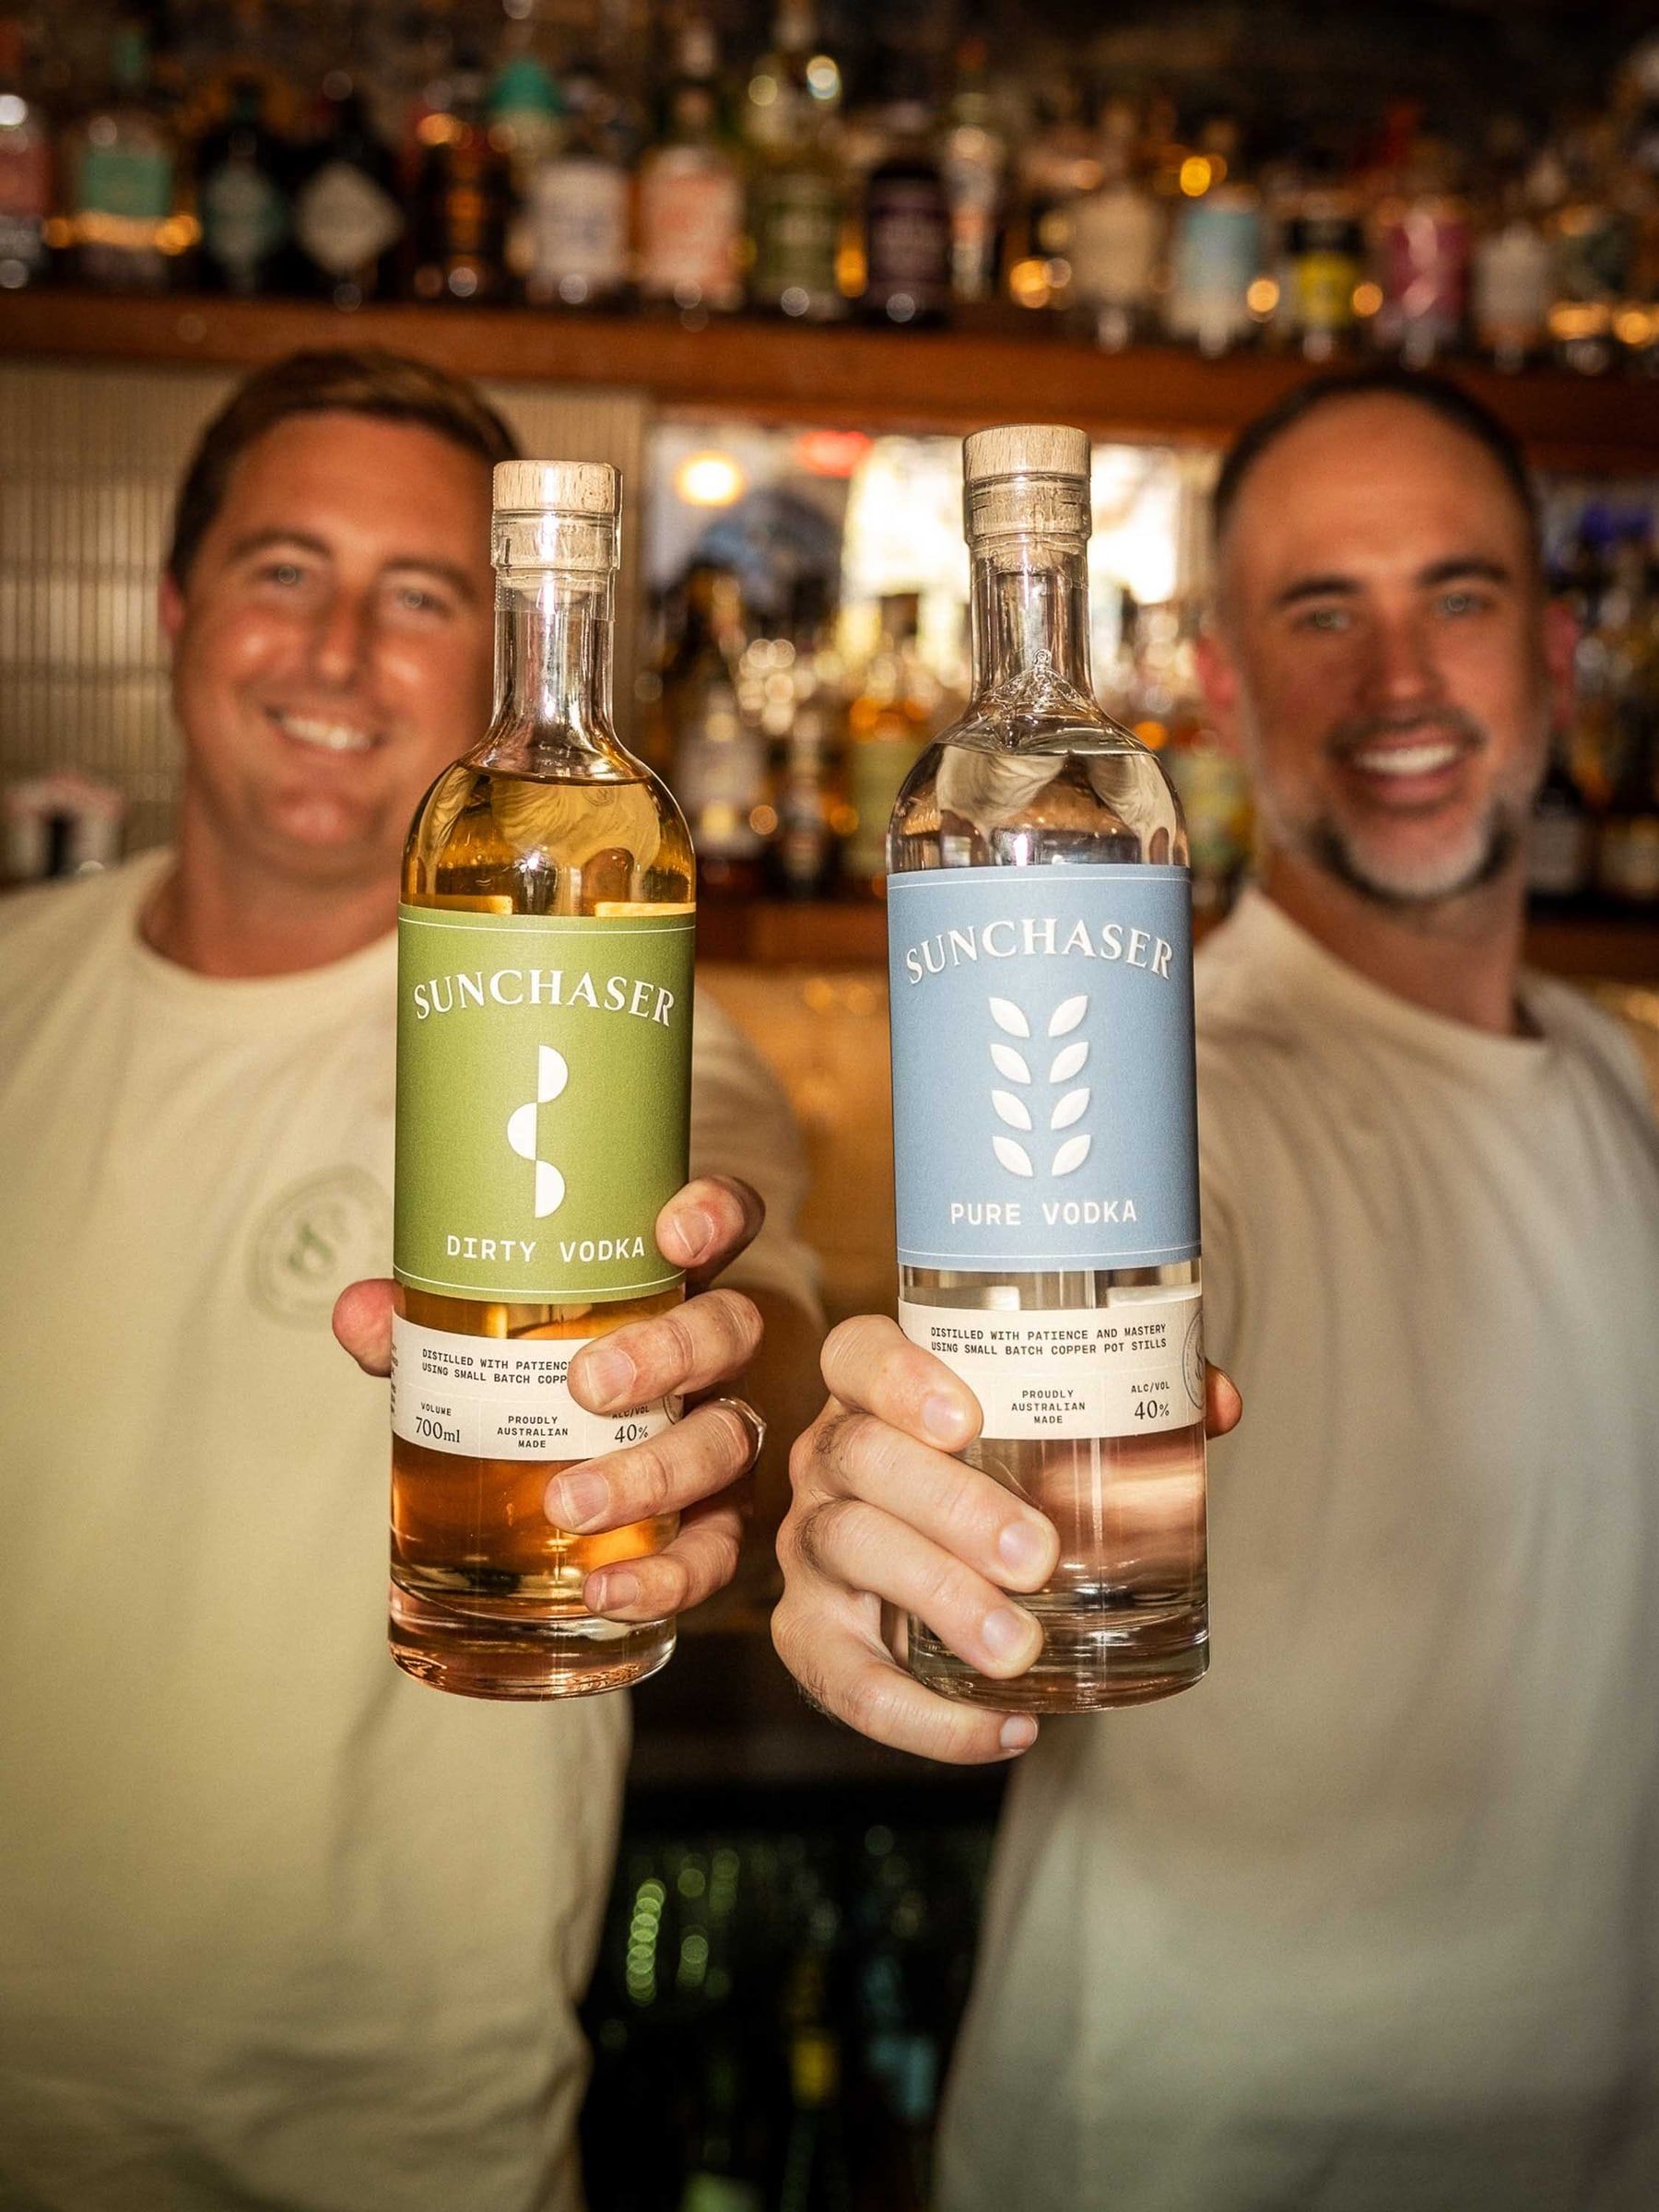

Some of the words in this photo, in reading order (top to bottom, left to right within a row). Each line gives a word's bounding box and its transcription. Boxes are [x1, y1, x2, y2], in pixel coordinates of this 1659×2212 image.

[906, 918, 1173, 985] SUNCHASER
[414, 969, 675, 1027] SUNCHASER
[951, 1203, 1021, 1226] PURE
[1042, 1200, 1137, 1226] VODKA
[447, 1235, 536, 1262] DIRTY
[559, 1236, 645, 1263] VODKA
[931, 1326, 983, 1340] DISTILLED
[990, 1330, 1019, 1340] WITH
[1028, 1329, 1088, 1341] PATIENCE
[1097, 1328, 1118, 1338] AND
[1124, 1324, 1167, 1336] MASTERY
[931, 1341, 959, 1353] USING
[964, 1343, 997, 1355] SMALL
[1006, 1346, 1043, 1356] BATCH
[1051, 1344, 1097, 1356] COPPER
[1104, 1342, 1124, 1353] POT
[1132, 1337, 1167, 1351] STILLS
[422, 1348, 474, 1367] DISTILLED
[480, 1358, 509, 1370] WITH
[515, 1360, 571, 1371] PATIENC
[422, 1362, 449, 1376] USING
[454, 1369, 487, 1382] SMALL
[494, 1373, 530, 1384] BATCH
[537, 1374, 568, 1384] COPP
[1021, 1389, 1075, 1399] PROUDLY
[1131, 1381, 1171, 1394] ALC/VOL
[420, 1402, 453, 1417] VOLUME
[1011, 1402, 1086, 1412] AUSTRALIAN
[1134, 1399, 1171, 1420] 40%
[415, 1416, 461, 1443] 700ml
[508, 1415, 559, 1426] PROUDLY
[1033, 1415, 1064, 1425] MADE
[497, 1427, 569, 1438] AUSTRALIAN
[614, 1423, 649, 1443] 40%
[517, 1440, 547, 1449] MADE
